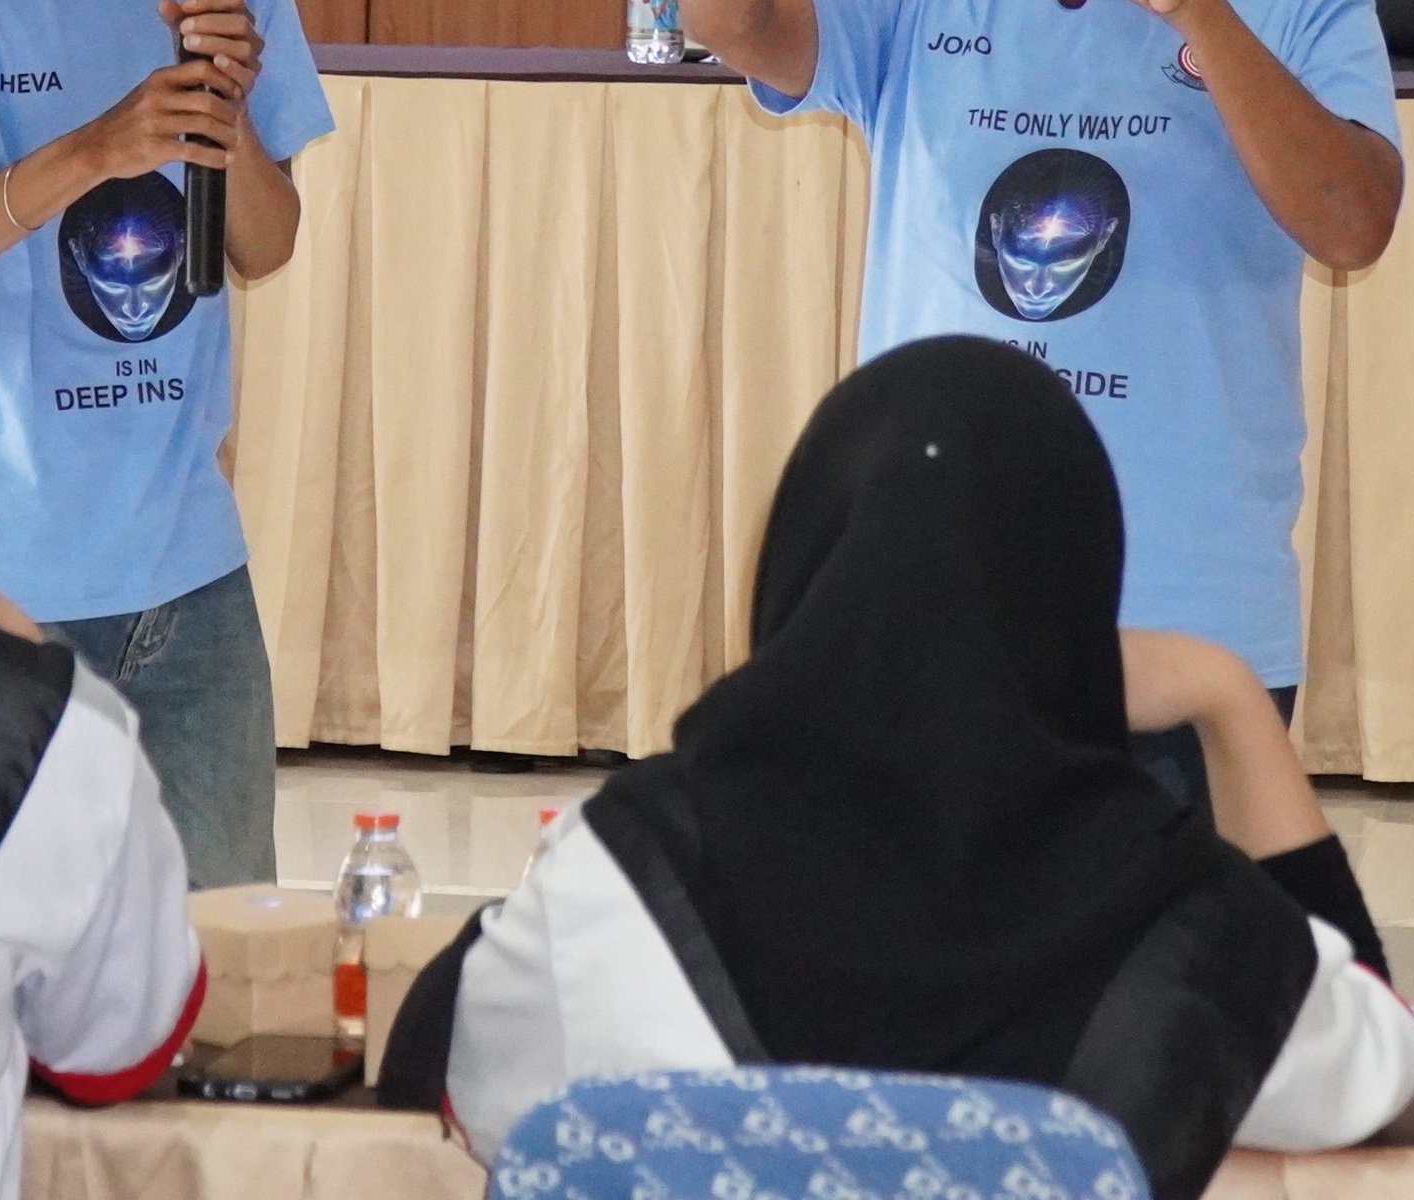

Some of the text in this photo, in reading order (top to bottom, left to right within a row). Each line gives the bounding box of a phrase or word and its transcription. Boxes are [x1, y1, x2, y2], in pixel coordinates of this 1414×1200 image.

[0, 71, 64, 94] HEVA
[968, 108, 1171, 140] THE ONLY WAY OUT
[116, 358, 158, 377] IS IN
[54, 378, 184, 411] DEEP INS
